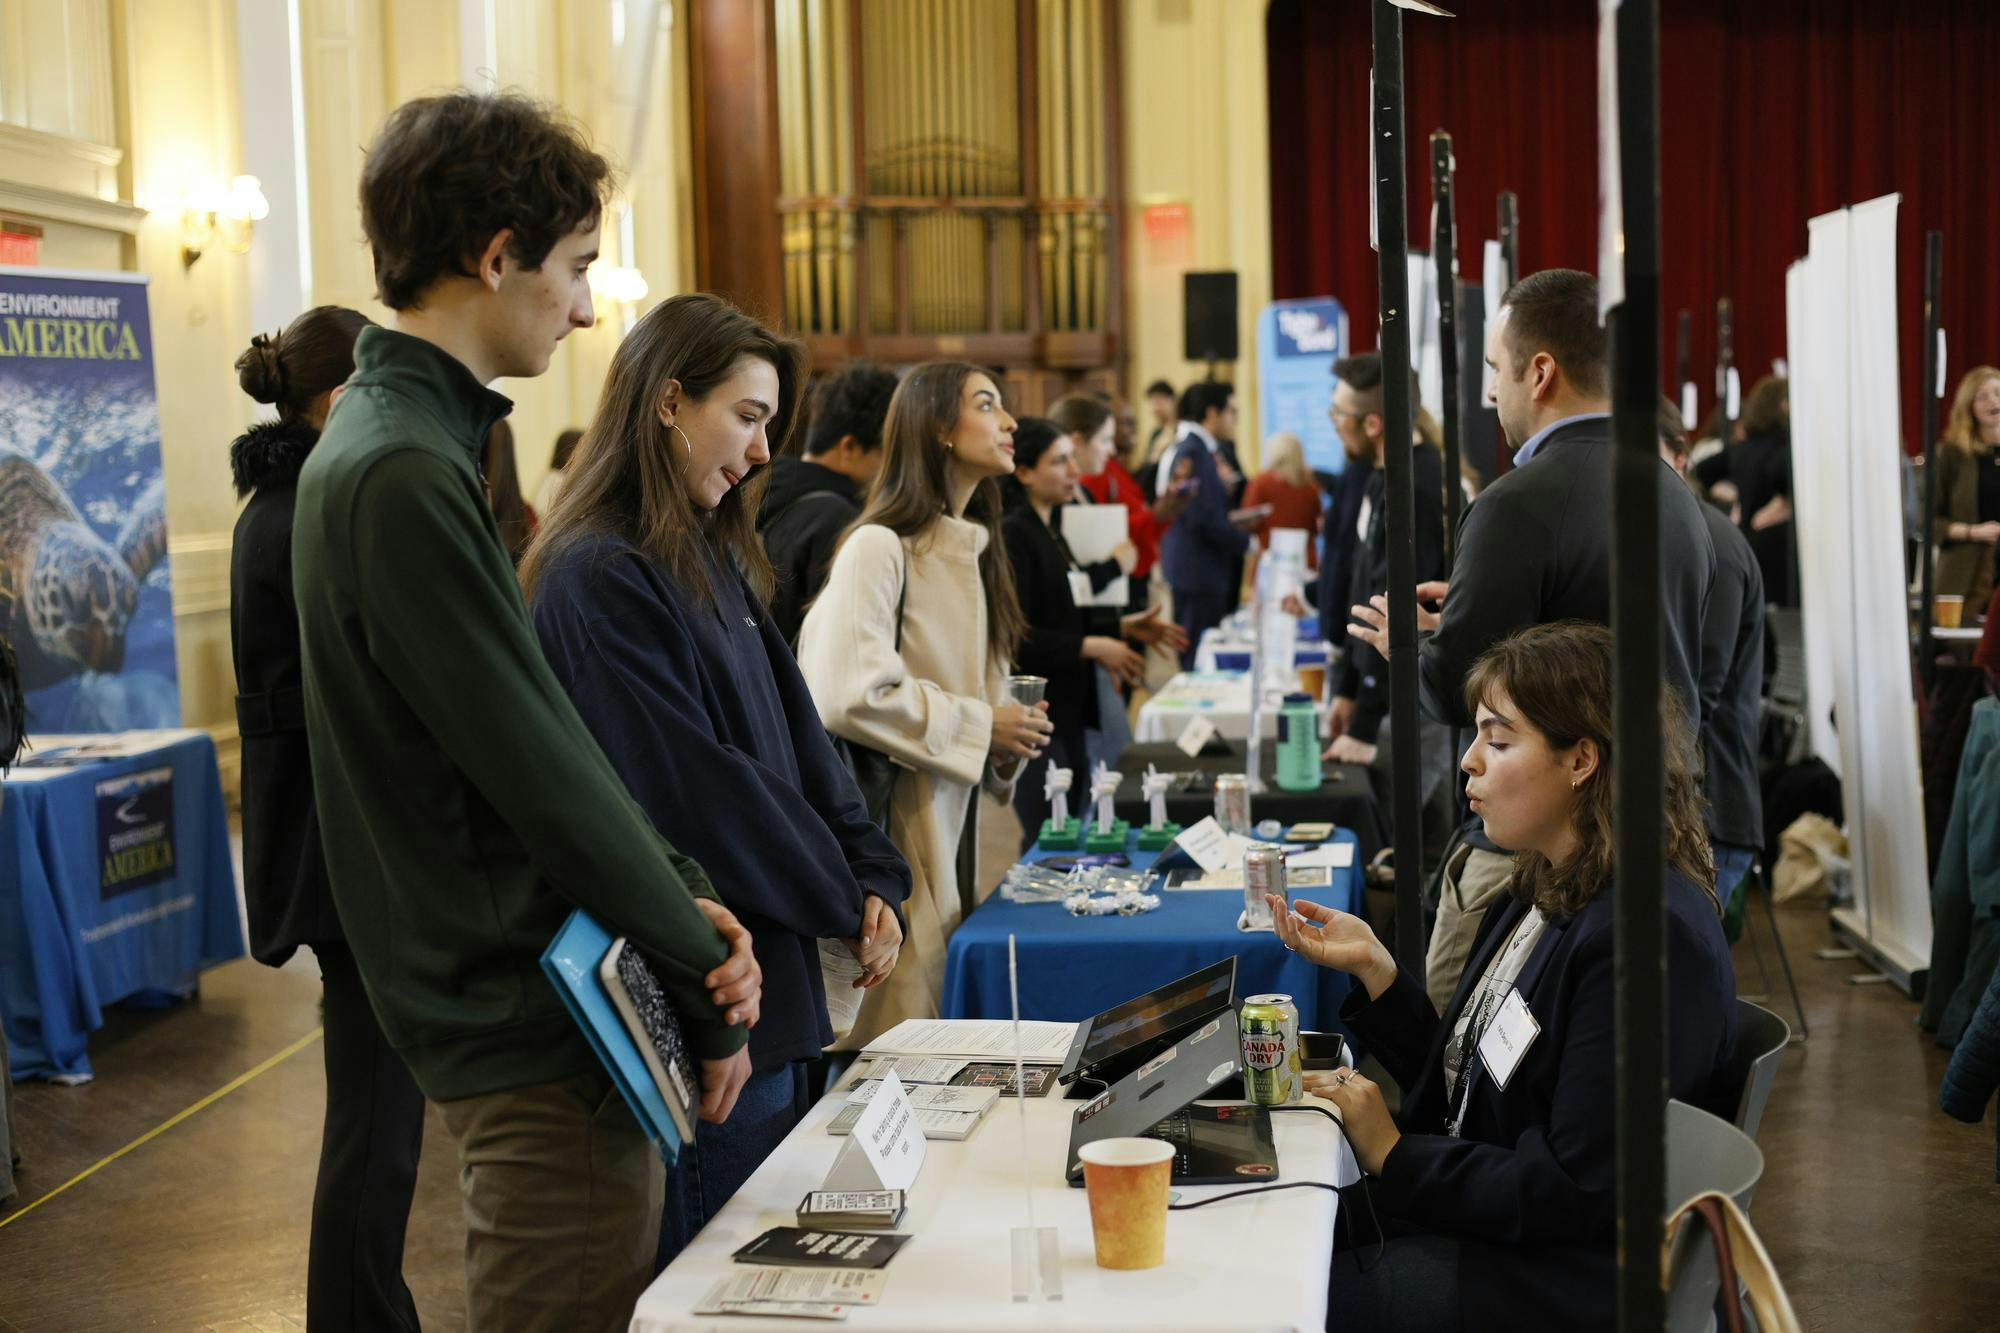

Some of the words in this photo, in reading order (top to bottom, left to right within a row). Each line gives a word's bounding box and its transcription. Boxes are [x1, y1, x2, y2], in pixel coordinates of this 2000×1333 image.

[0, 292, 120, 319] ENVIRONMENT
[1242, 1041, 1285, 1053] CANADA
[1250, 1053, 1273, 1063] DRY
